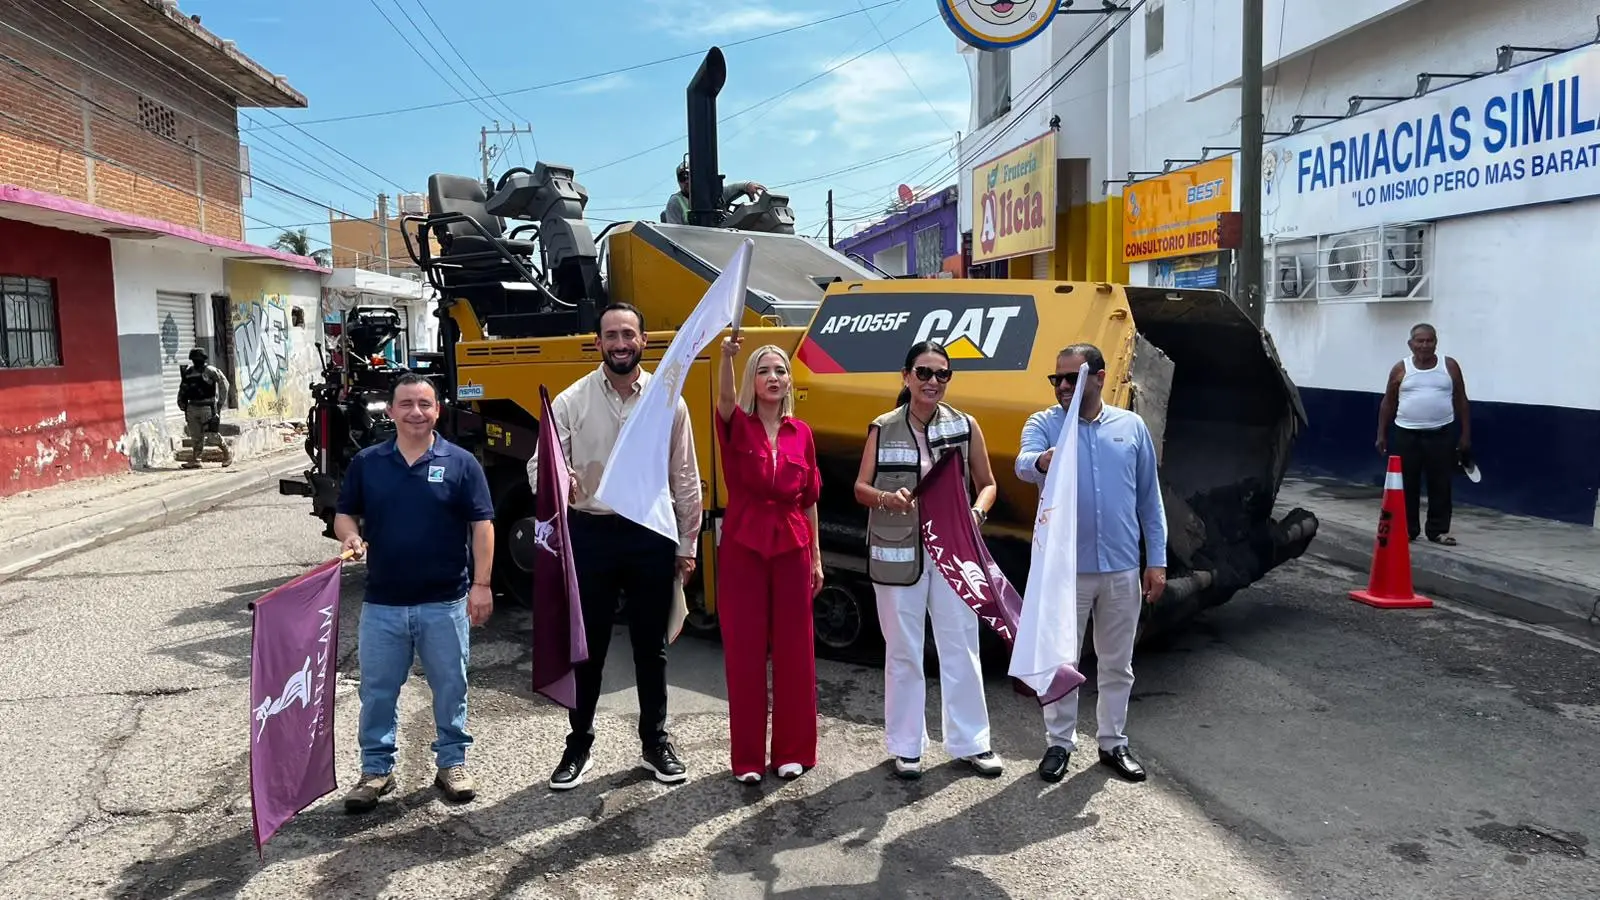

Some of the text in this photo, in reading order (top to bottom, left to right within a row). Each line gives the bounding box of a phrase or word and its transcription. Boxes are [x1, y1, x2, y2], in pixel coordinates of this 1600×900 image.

[1297, 75, 1600, 193] FARMACIAS SIMIL
[1187, 178, 1225, 204] BEST
[1352, 144, 1600, 208] "LO MISMO PERO MAS BARAT
[981, 182, 1043, 246] Alicia
[1125, 228, 1218, 257] CONSULTORIO MEDIC
[820, 306, 1021, 358] AP1055F CAT
